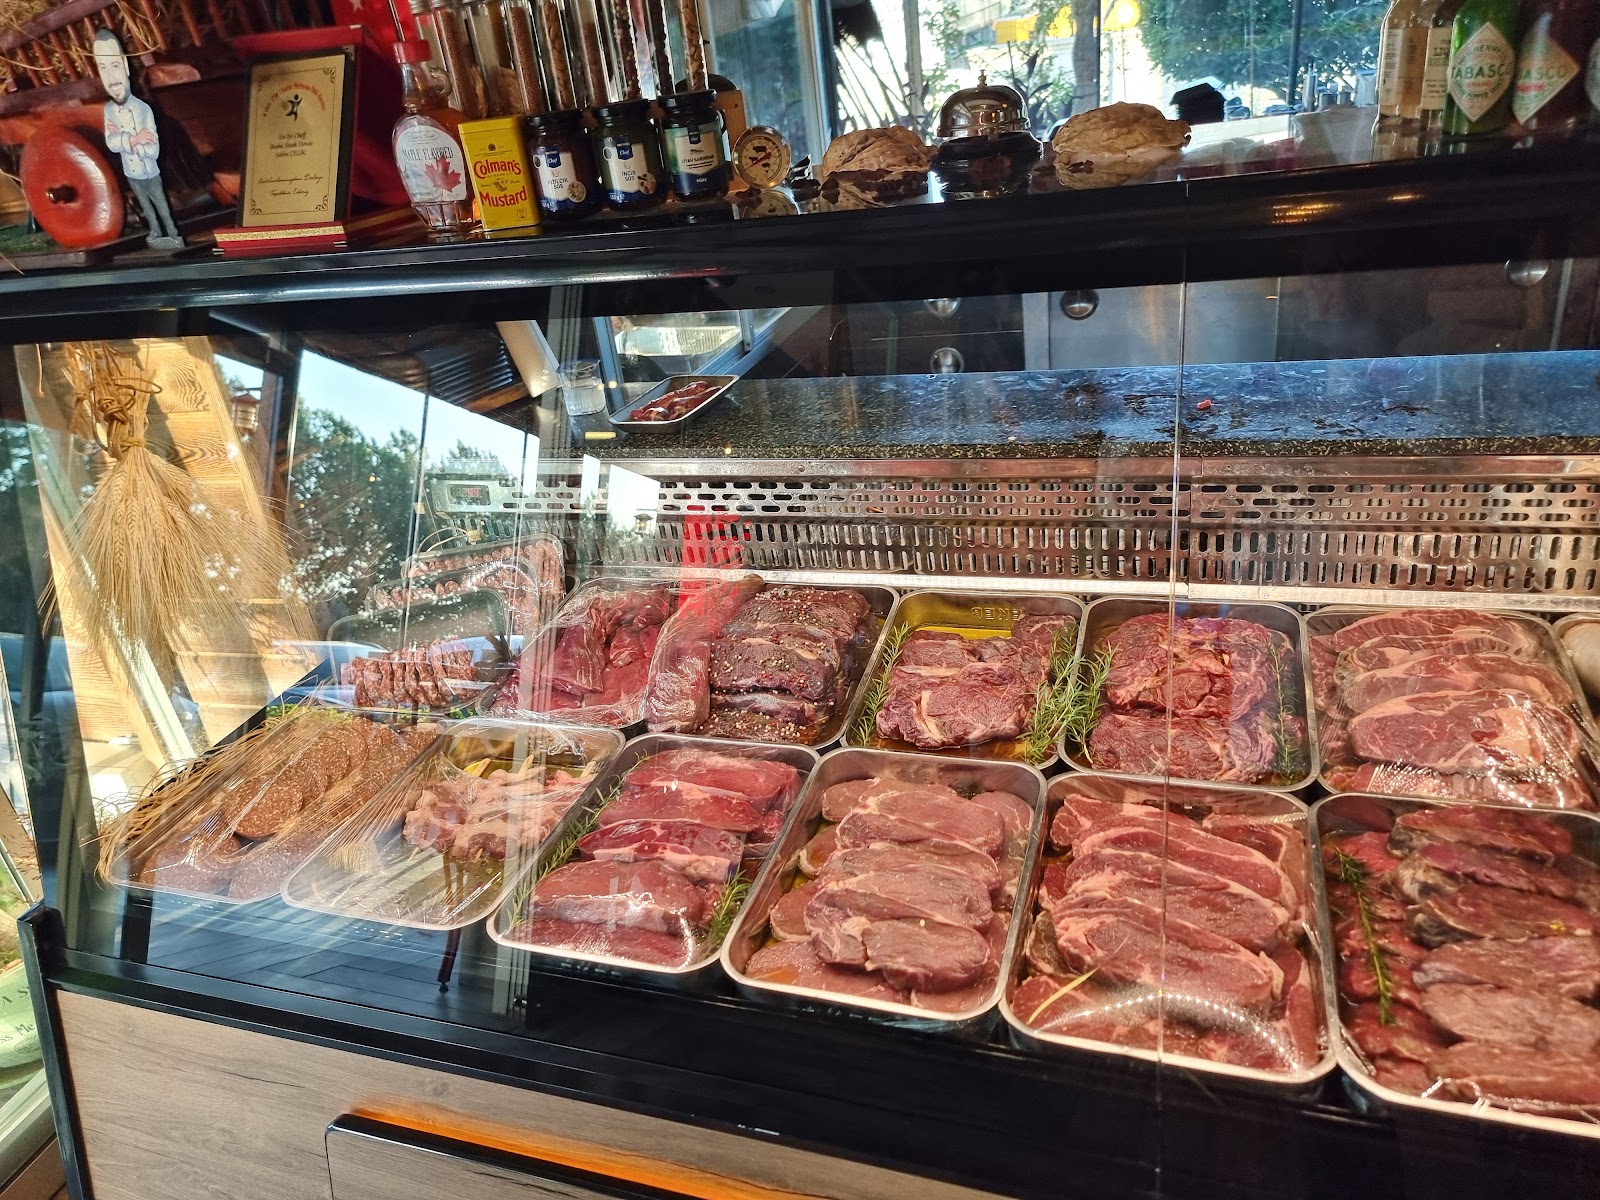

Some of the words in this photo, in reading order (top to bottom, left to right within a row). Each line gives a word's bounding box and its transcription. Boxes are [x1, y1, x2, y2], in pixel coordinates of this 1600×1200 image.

[1450, 62, 1514, 79] TABASCO
[473, 159, 522, 179] Colman's
[479, 185, 528, 207] Mustard
